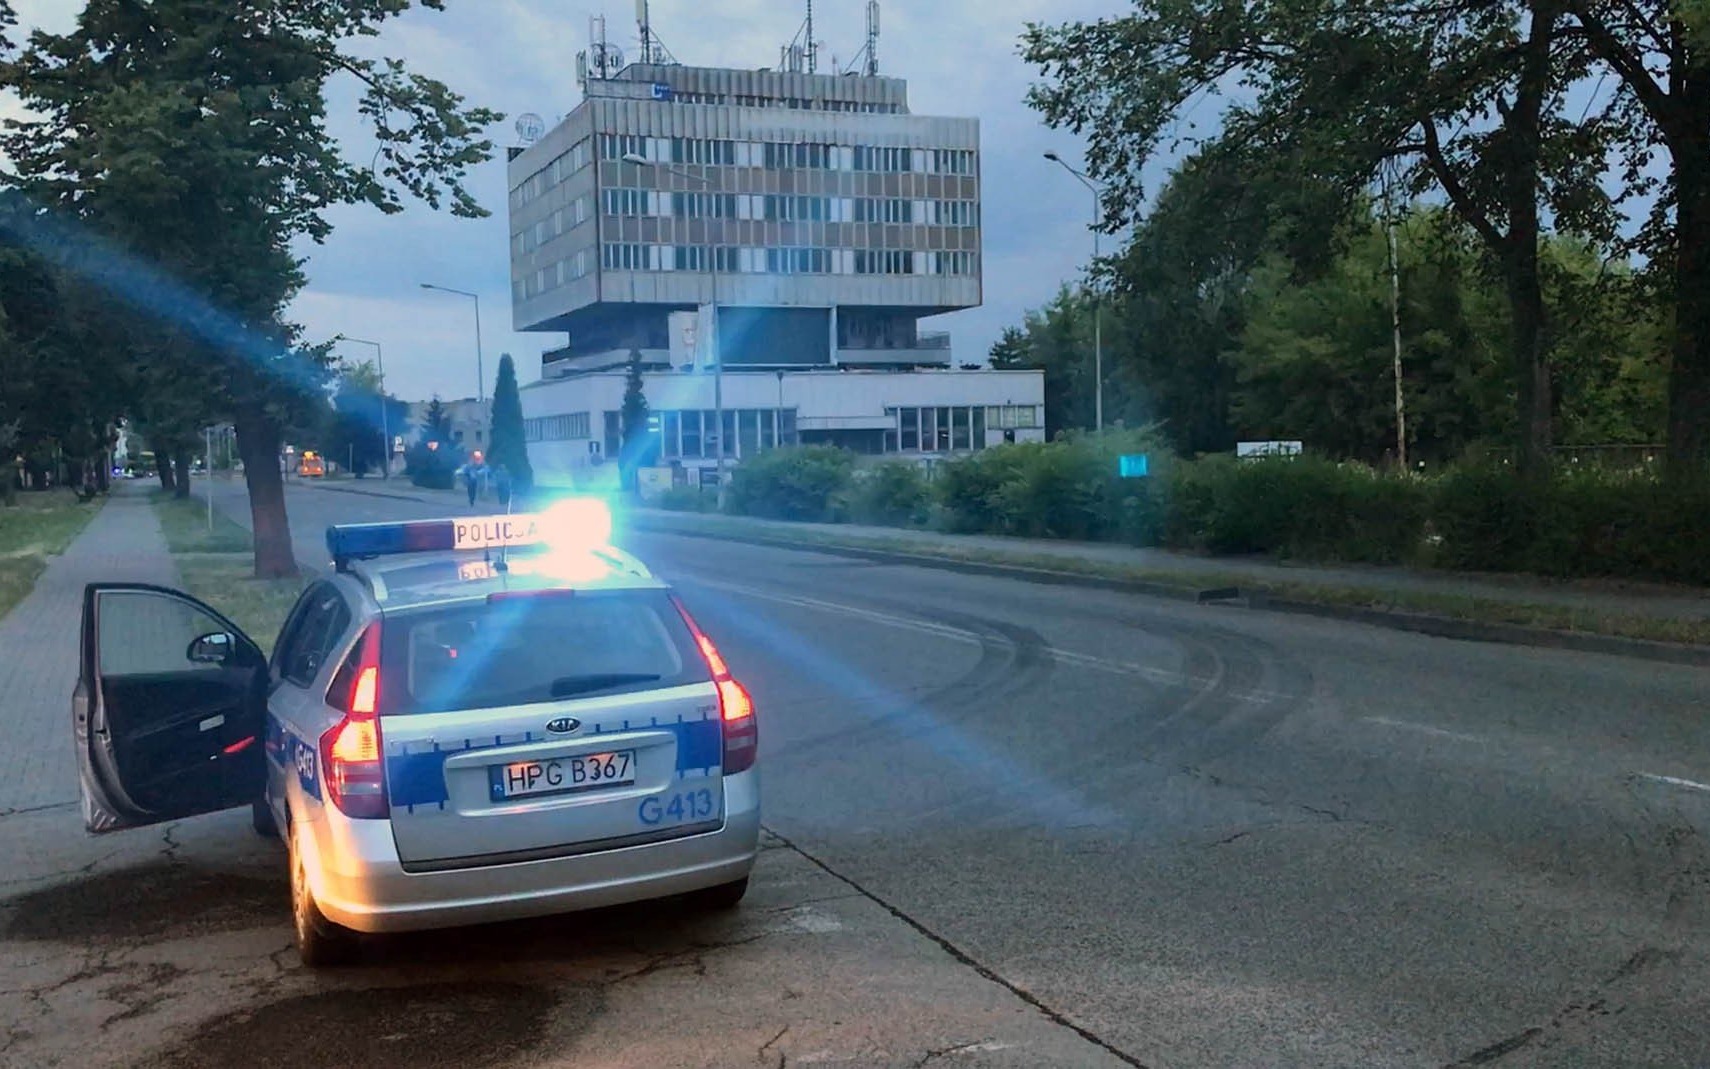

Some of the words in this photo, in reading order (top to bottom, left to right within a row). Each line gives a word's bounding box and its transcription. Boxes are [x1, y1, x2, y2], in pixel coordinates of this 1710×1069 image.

[508, 763, 562, 791] HPG
[572, 754, 629, 783] B367
[639, 788, 712, 825] G413
